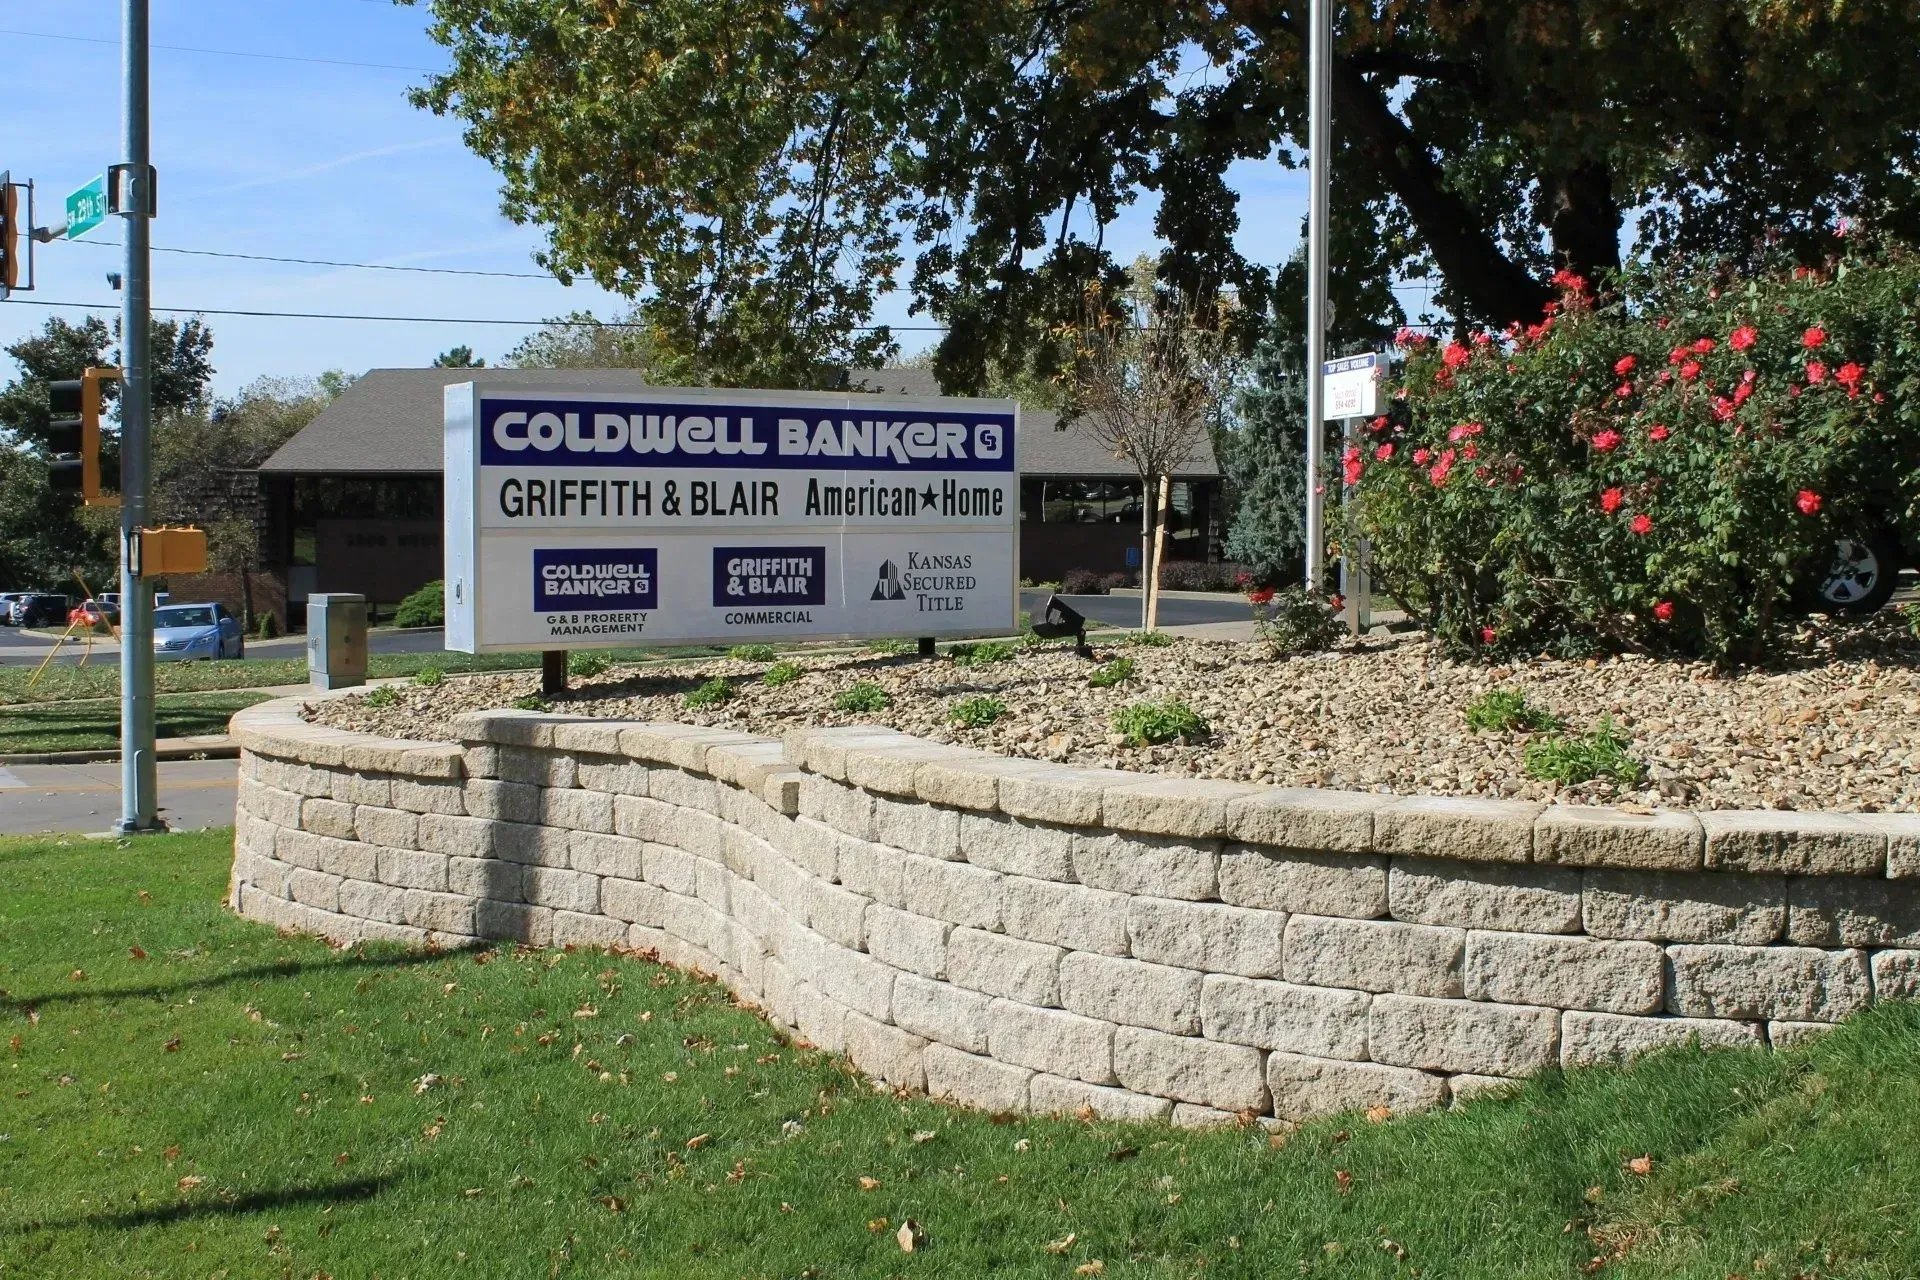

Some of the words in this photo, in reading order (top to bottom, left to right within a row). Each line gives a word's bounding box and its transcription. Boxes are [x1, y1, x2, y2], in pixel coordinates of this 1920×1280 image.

[493, 411, 767, 455] COLDWELL
[778, 418, 968, 464] BANKER
[500, 478, 651, 518] GRIFFITH
[661, 479, 682, 517] &
[690, 481, 779, 516] BLAIR
[805, 477, 916, 516] American
[942, 479, 1003, 516] Home
[727, 557, 812, 577] GRIFFITH
[908, 552, 972, 570] KANSAS
[542, 564, 650, 580] COLDWELL
[544, 580, 630, 597] BANKER
[727, 576, 745, 596] &
[748, 577, 808, 595] BLAIR
[903, 573, 976, 591] SECURED
[916, 593, 964, 612] TITLE
[546, 615, 557, 624] G
[559, 615, 568, 624] &
[571, 615, 579, 624] B
[725, 611, 812, 625] COMMERCIAL
[550, 623, 644, 636] MANAGEMENT
